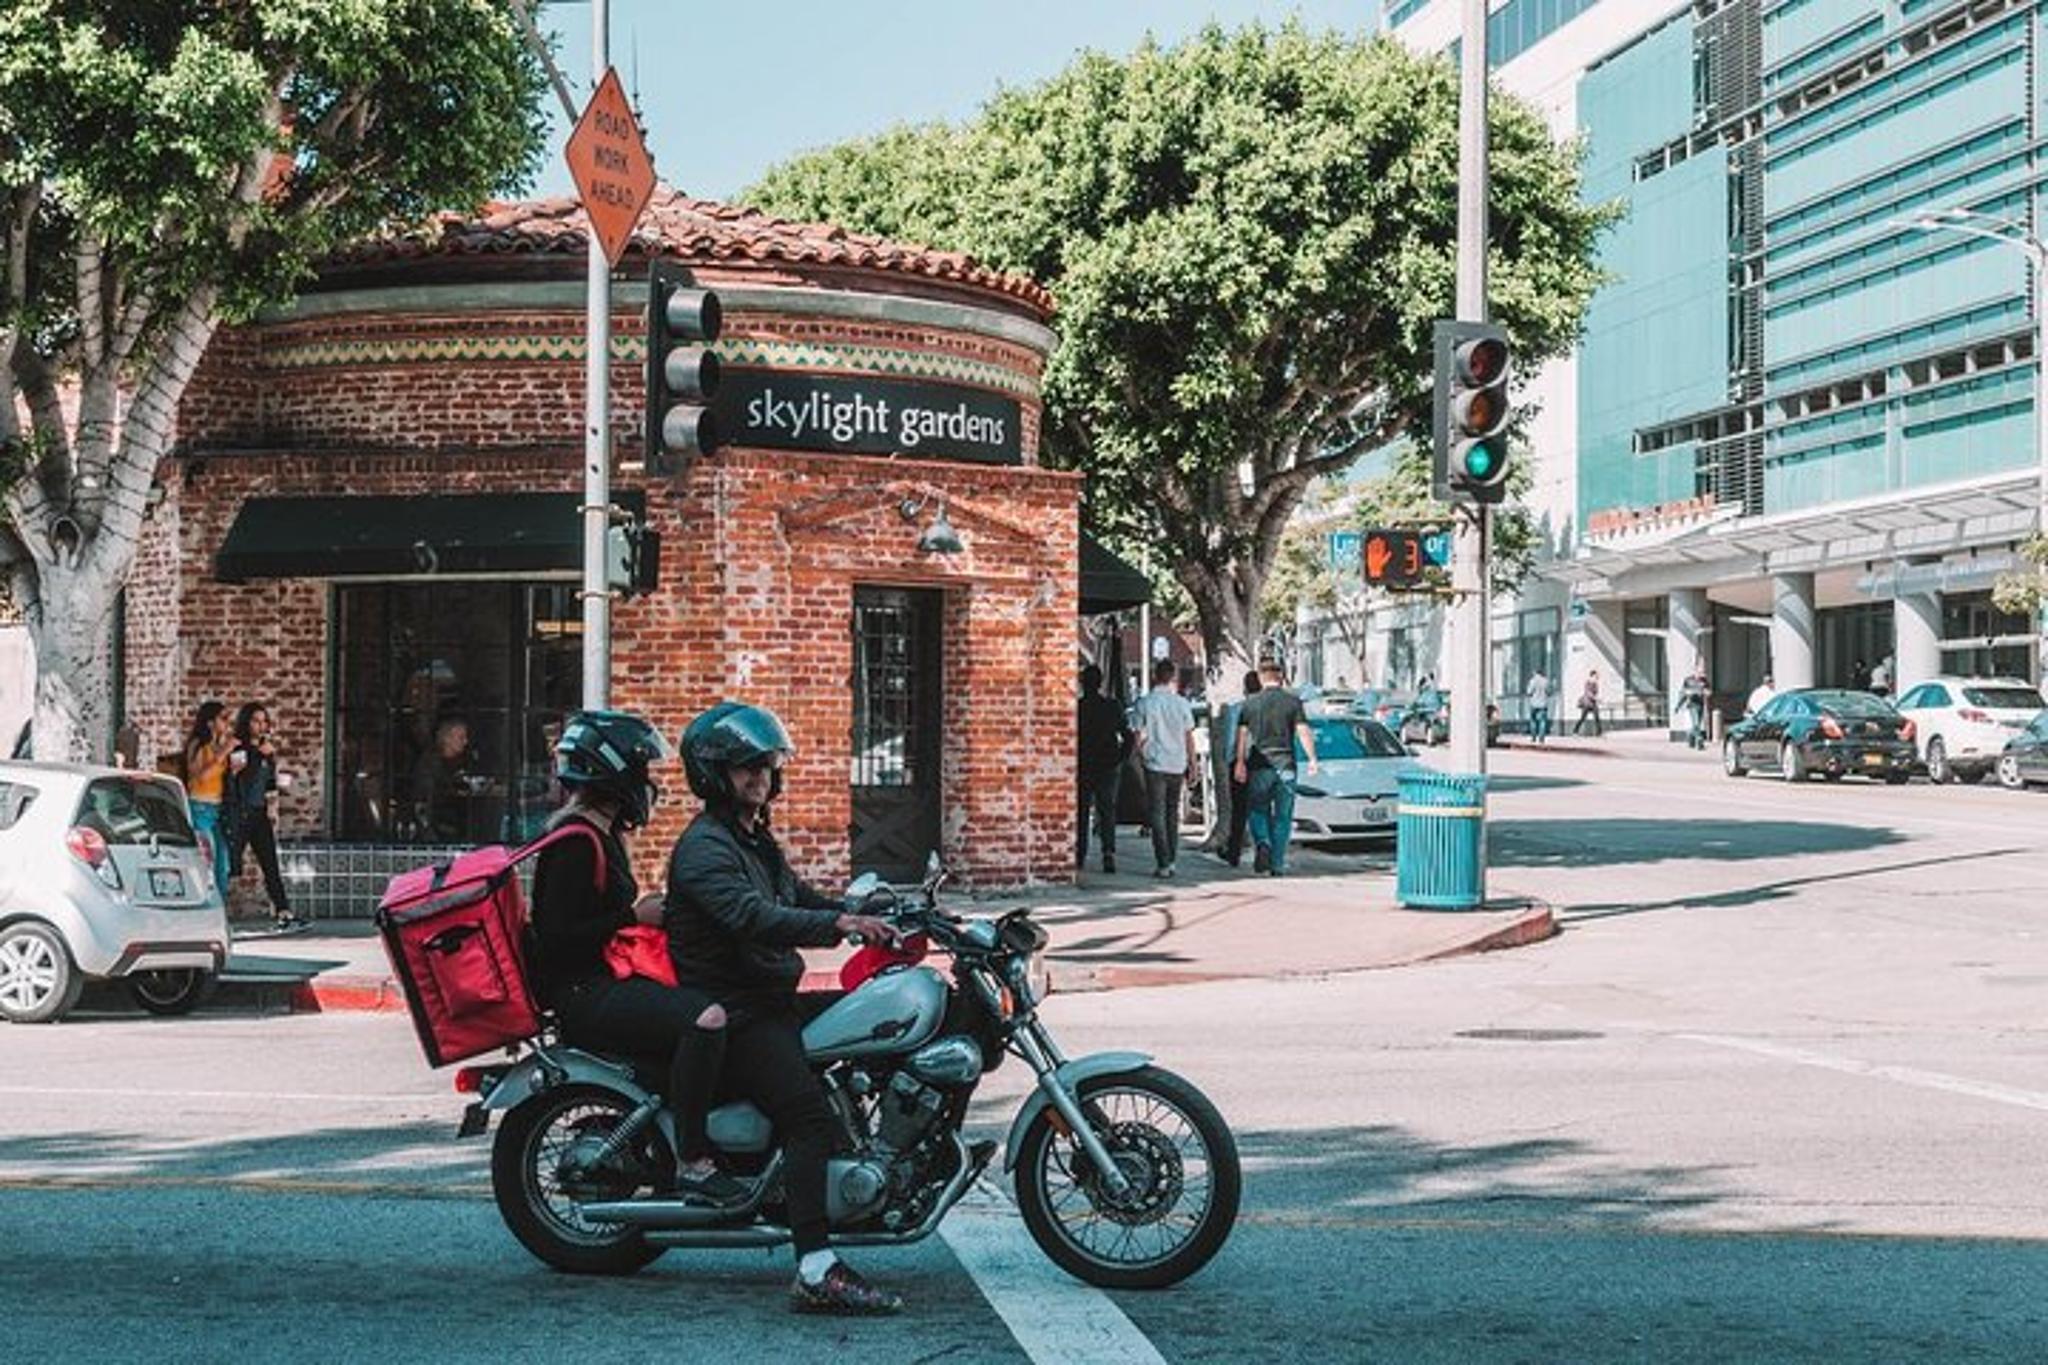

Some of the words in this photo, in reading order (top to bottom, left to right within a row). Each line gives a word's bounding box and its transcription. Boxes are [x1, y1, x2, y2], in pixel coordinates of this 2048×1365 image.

[594, 111, 629, 140] ROAD
[593, 146, 629, 175] WORK
[591, 181, 634, 210] AHEAD
[747, 388, 890, 442] skylight
[899, 403, 1005, 446] gardens
[1404, 539, 1419, 576] 3
